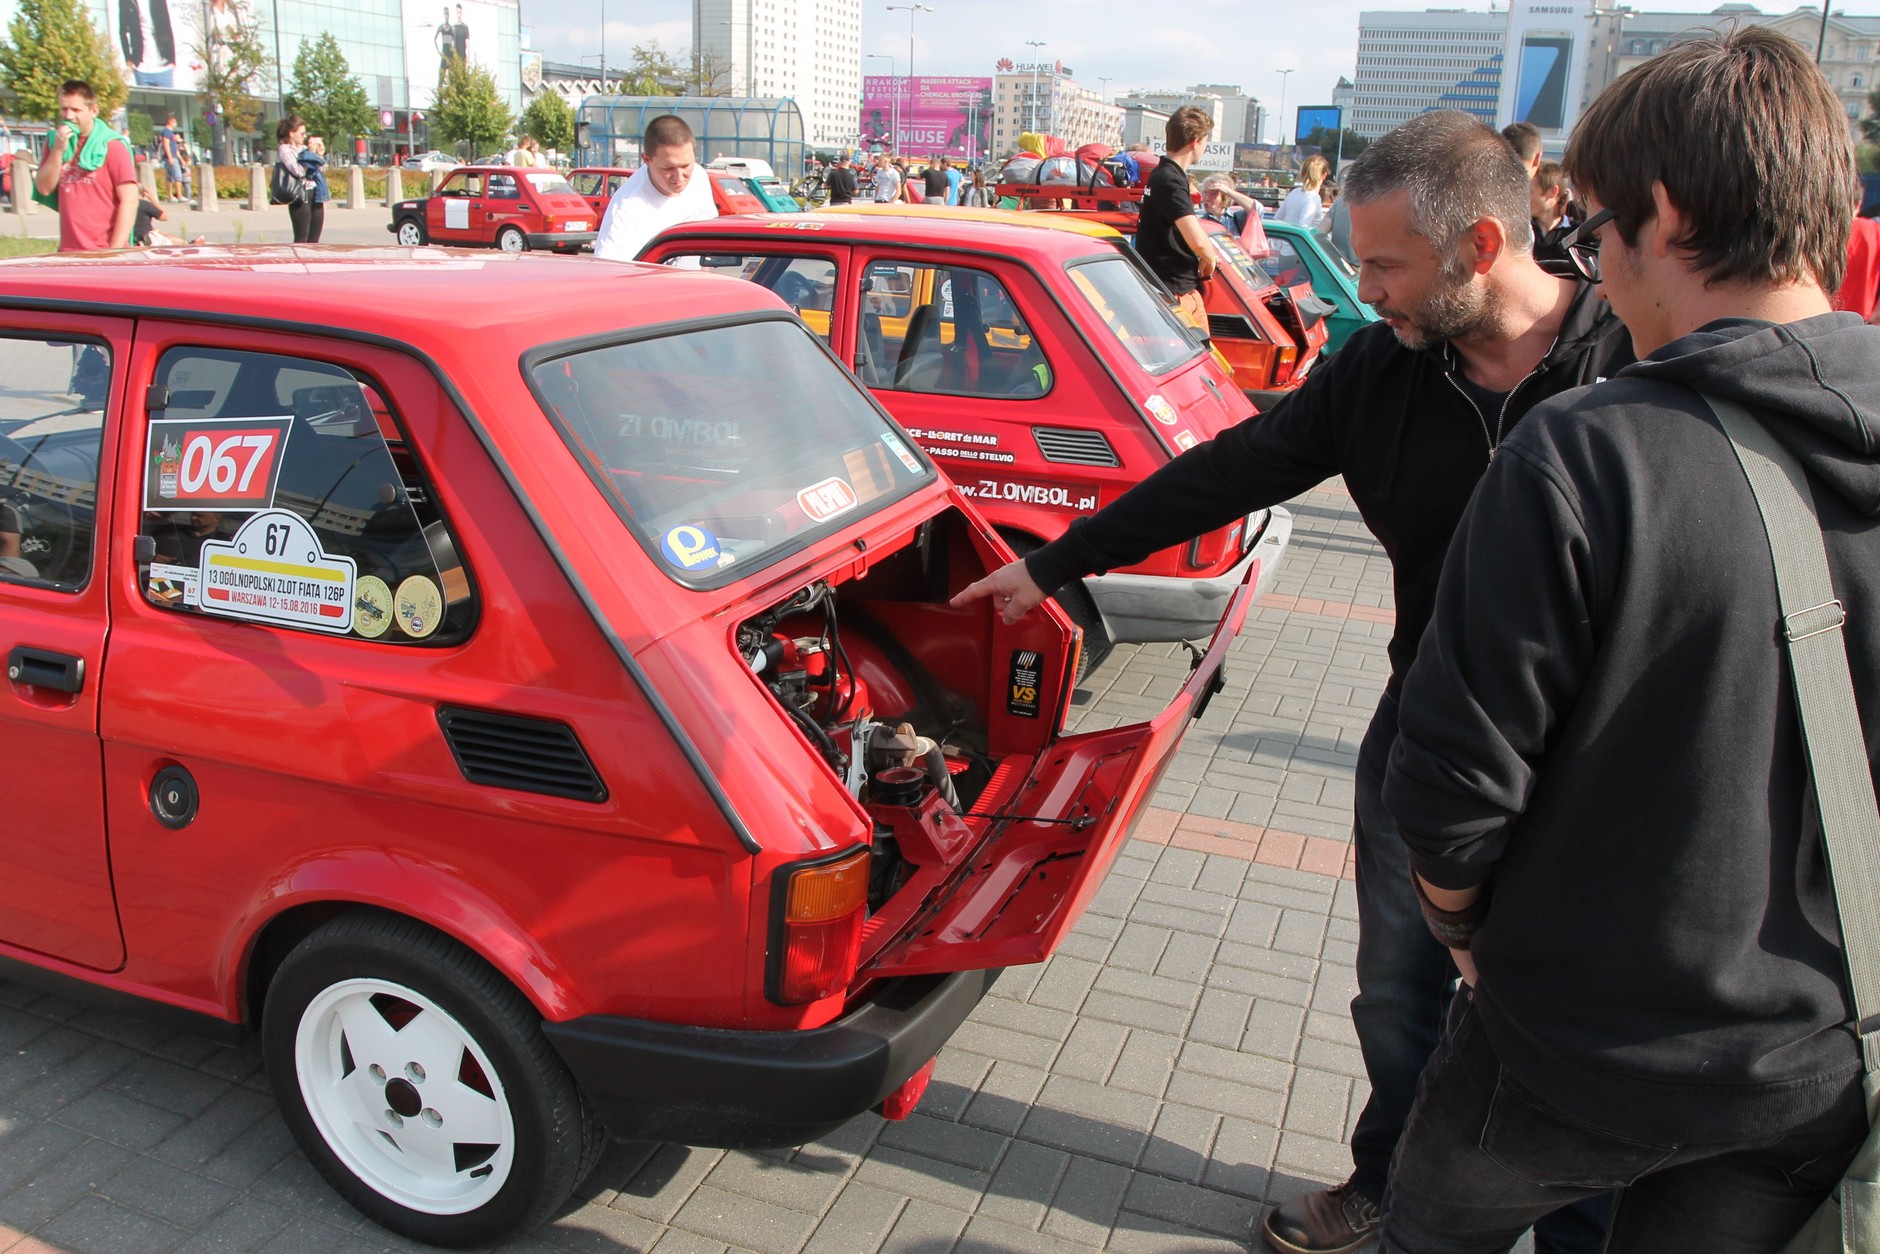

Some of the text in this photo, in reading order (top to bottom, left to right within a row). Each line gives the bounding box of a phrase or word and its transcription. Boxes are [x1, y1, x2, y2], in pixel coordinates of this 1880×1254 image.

[1528, 6, 1573, 14] SAMSUNG
[1016, 63, 1053, 71] HUAWEI
[899, 129, 946, 144] MUSE
[973, 435, 998, 446] MAR
[180, 434, 273, 494] 067
[960, 450, 978, 458] DELLO
[979, 453, 1014, 463] STELVIO
[955, 481, 1095, 509] w.ZLOMBOL.pl
[264, 523, 291, 557] 67
[208, 569, 218, 584] 13
[219, 570, 277, 593] OGÓLNOPOLSKI
[277, 579, 297, 596] ZLOT
[298, 583, 321, 599] FIATA
[323, 585, 345, 602] 126P
[231, 590, 318, 615] WARSZAWA 12-15.08.2016
[1013, 685, 1036, 701] VS
